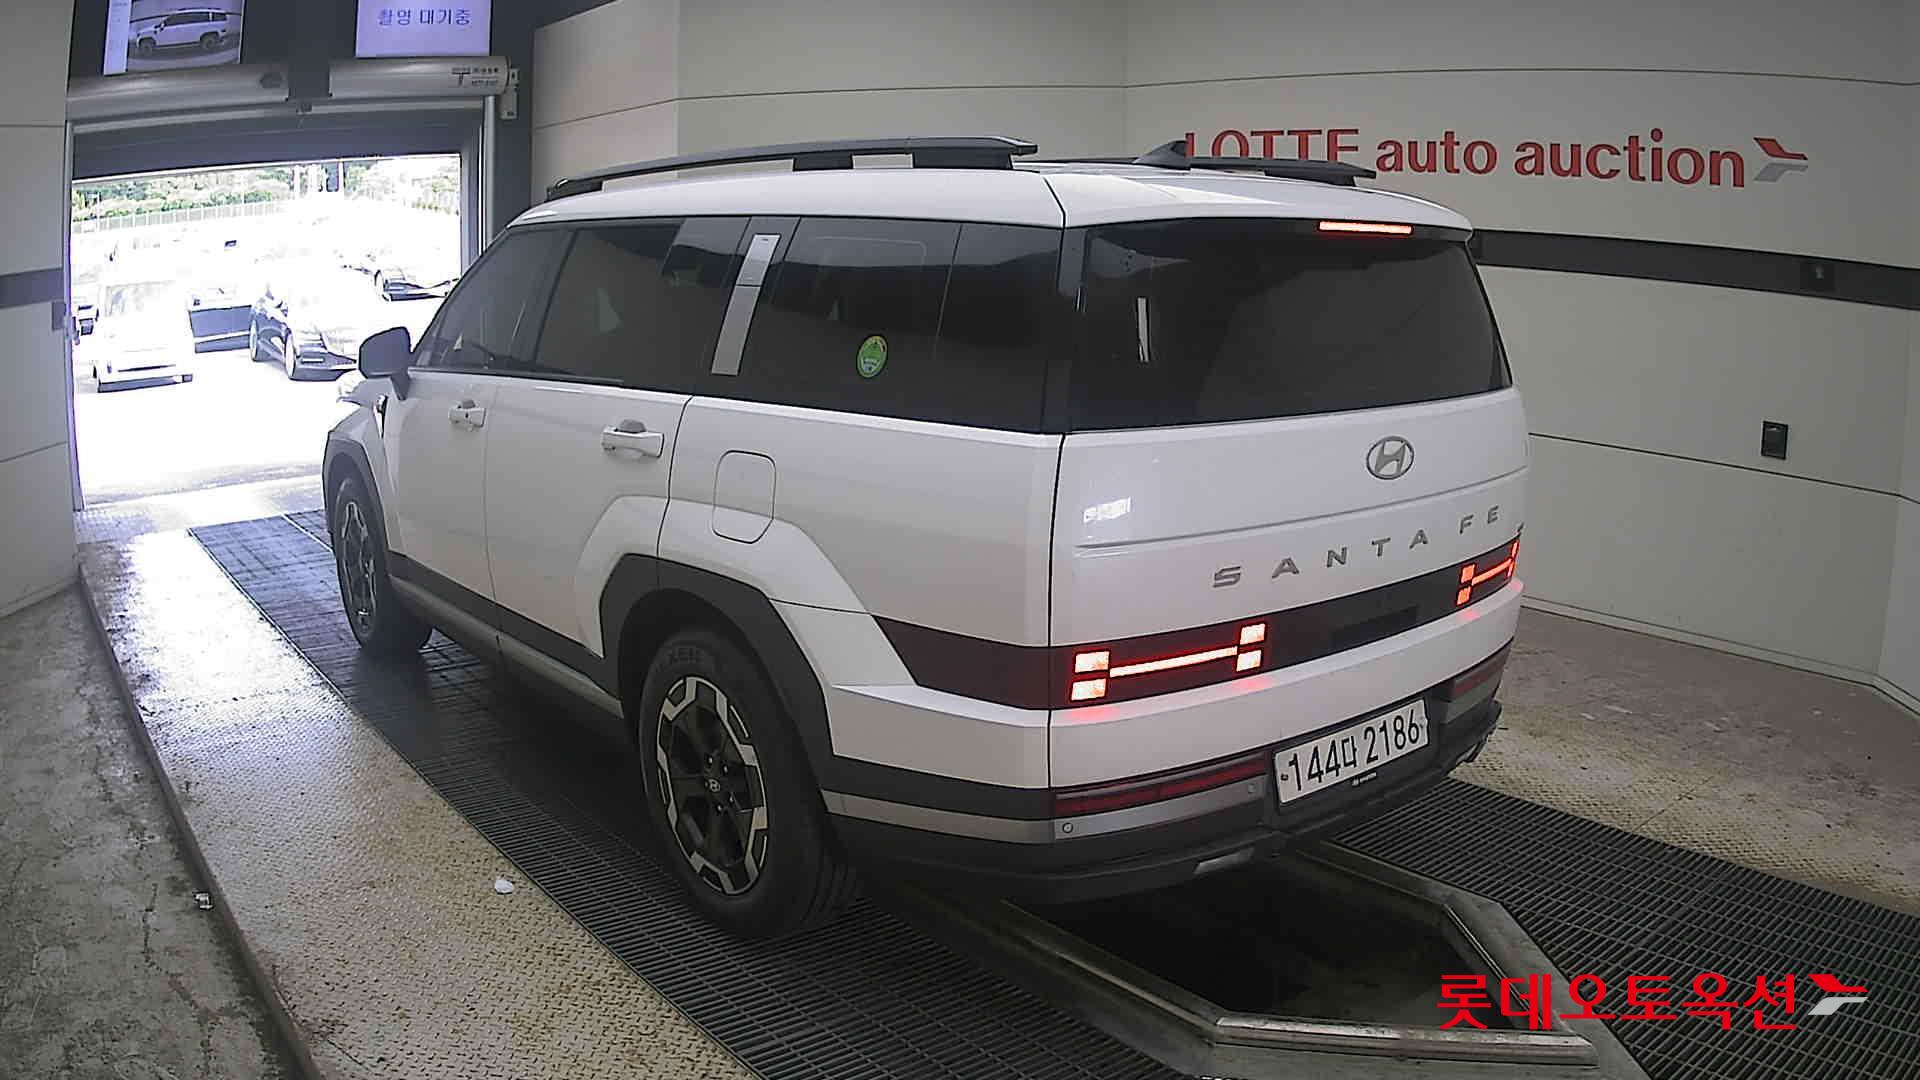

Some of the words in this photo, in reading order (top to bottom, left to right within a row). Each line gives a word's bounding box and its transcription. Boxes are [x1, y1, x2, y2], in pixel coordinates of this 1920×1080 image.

[420, 8, 471, 26] 대기중
[1376, 131, 1498, 174] auto
[1514, 128, 1744, 187] auction
[1212, 529, 1428, 588] SANTA
[1458, 505, 1500, 534] FE
[1288, 735, 1357, 791] 144다
[1364, 709, 1420, 764] 2186
